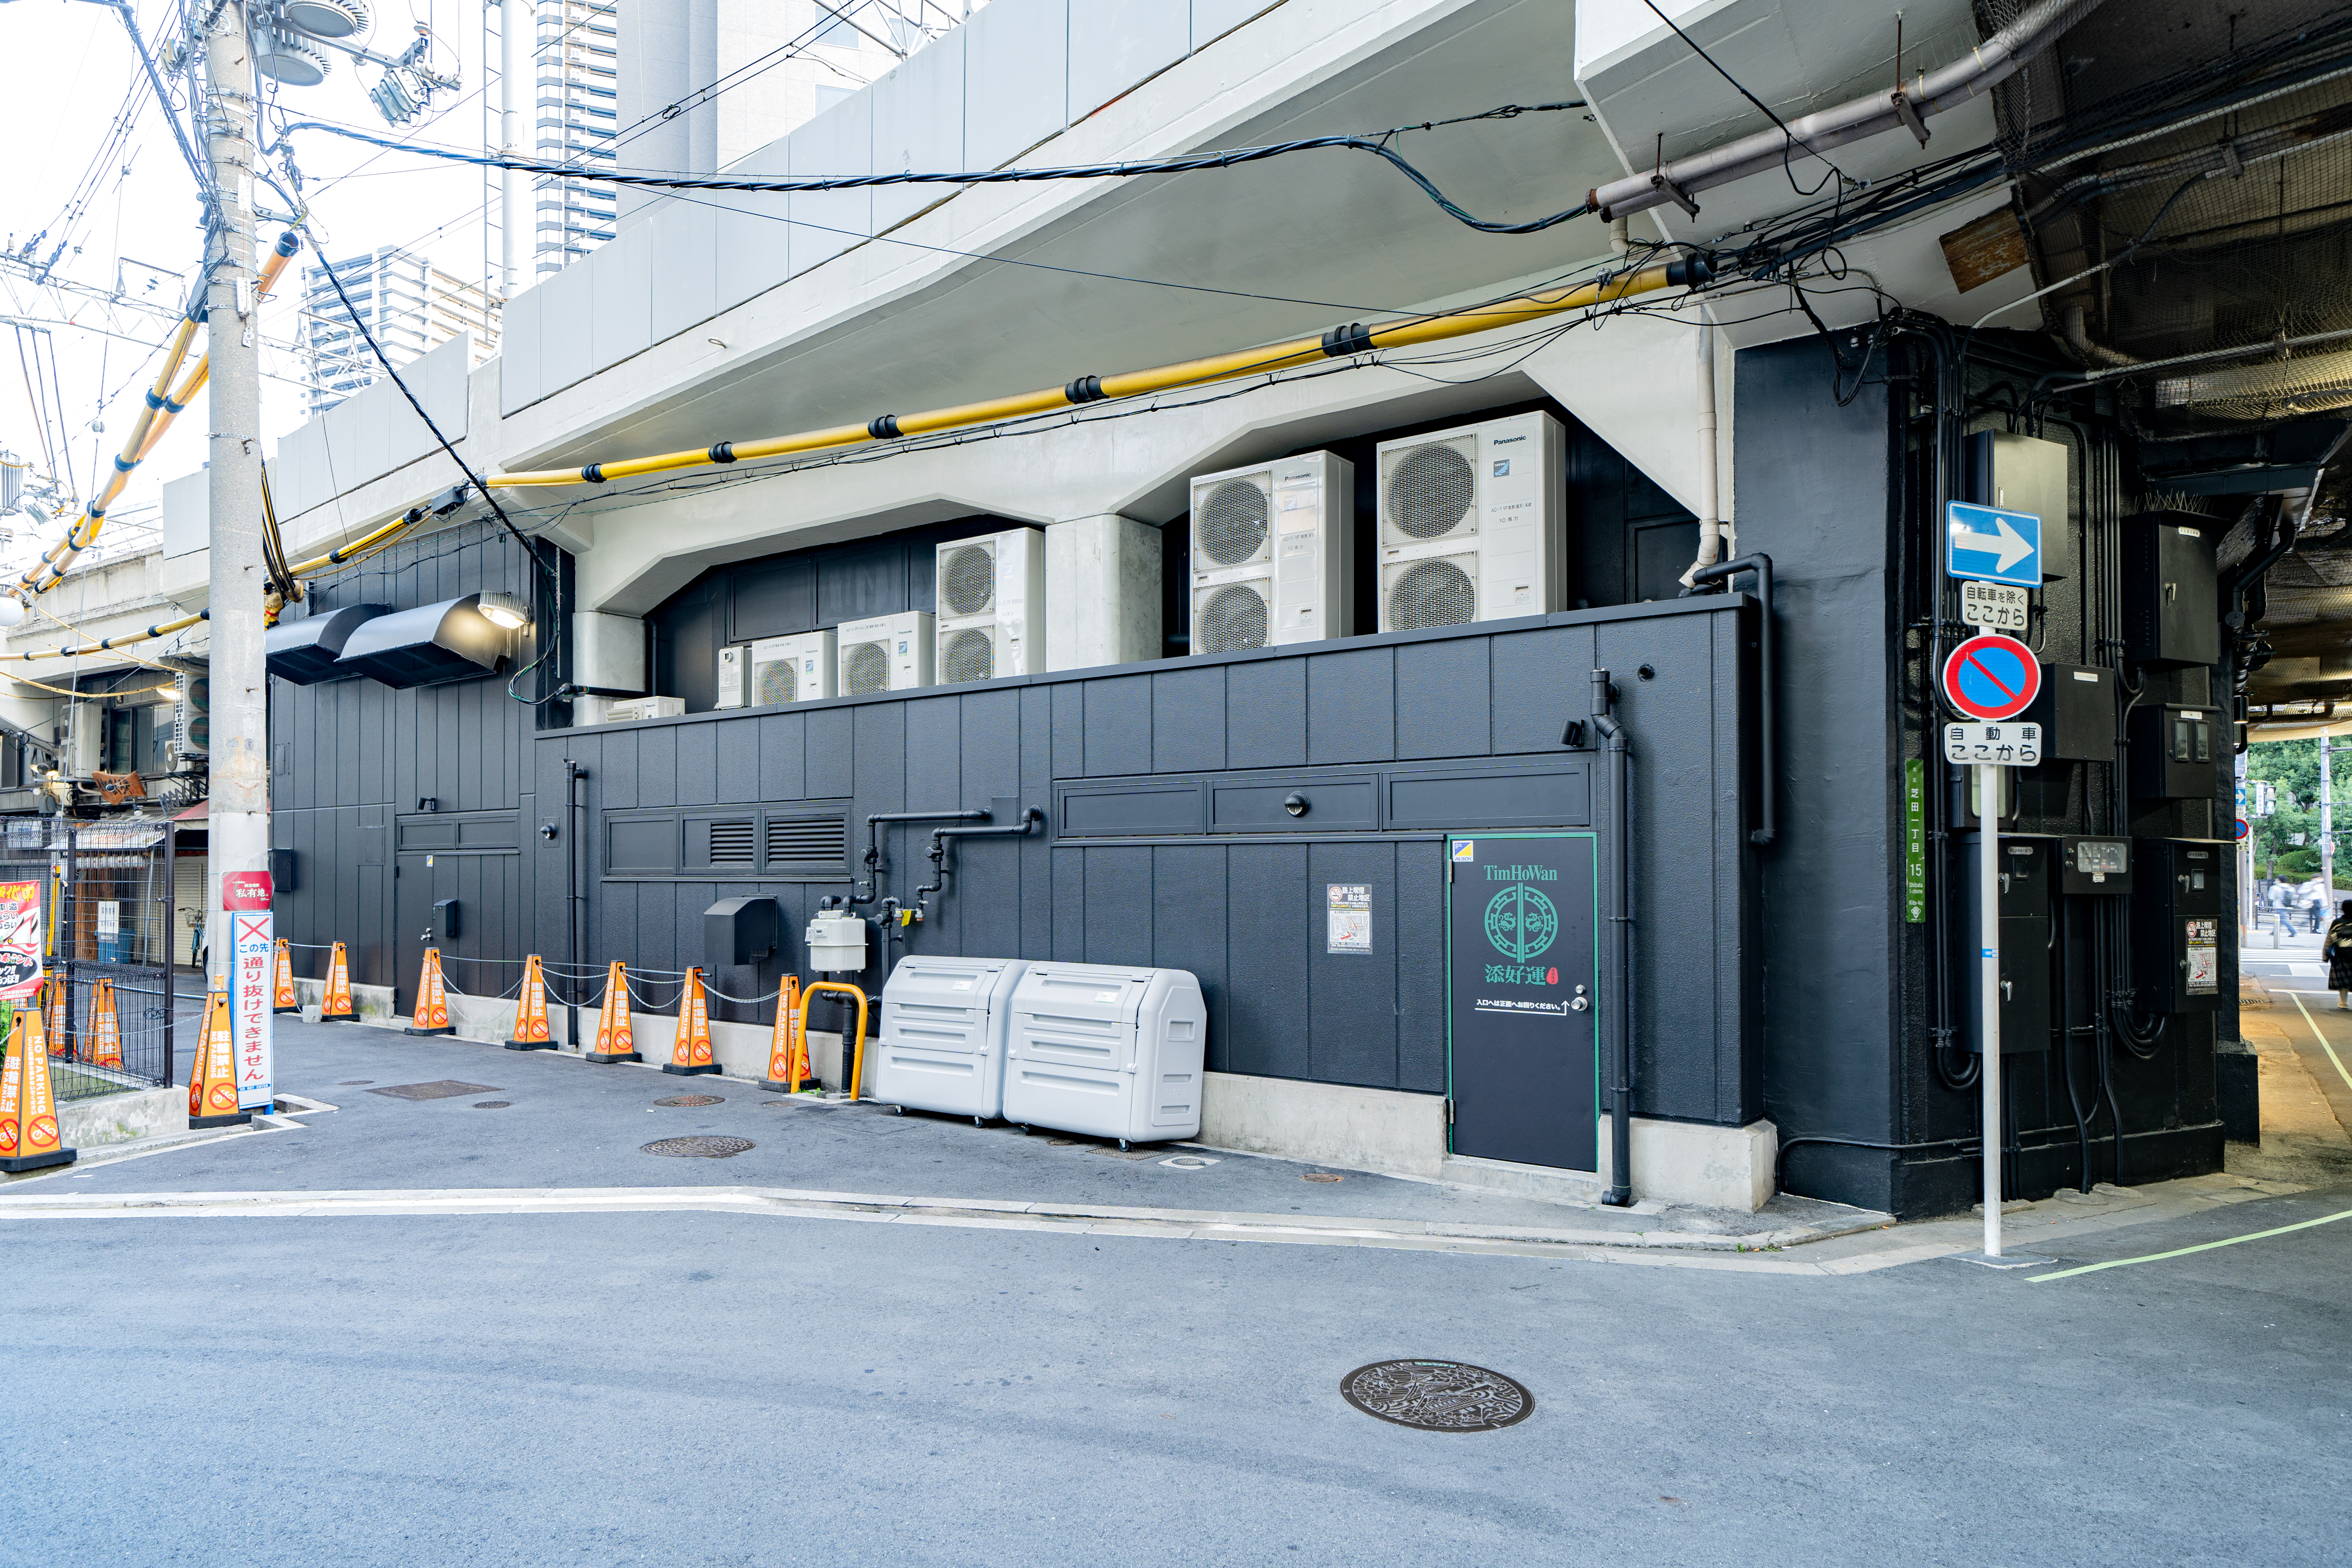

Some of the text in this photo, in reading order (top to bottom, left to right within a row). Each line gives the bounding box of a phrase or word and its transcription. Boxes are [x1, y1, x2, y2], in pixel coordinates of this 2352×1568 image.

[1494, 436, 1526, 445] Panasonic
[1285, 472, 1311, 481] Panasonic
[1967, 586, 2024, 605] 自転車を除く
[1967, 604, 2025, 626] ここから
[1951, 726, 2036, 740] 自動車
[1951, 745, 2036, 761] ここから
[1911, 788, 1919, 853] 芝田一丁目
[1484, 865, 1558, 881] TimHoWan
[1910, 864, 1922, 876] 15
[236, 888, 265, 898] 私有地
[240, 943, 269, 953] この先
[426, 963, 429, 973] NO
[1485, 964, 1546, 985] 添好運
[526, 971, 530, 982] NO
[610, 978, 614, 989] NO
[687, 985, 691, 997] NO
[520, 985, 528, 1018] PARKING
[693, 999, 697, 1007] NO
[782, 995, 787, 1007] NO
[1477, 999, 1560, 1010] 入口へは正面へお回りください。
[603, 992, 612, 1028] PARKING
[697, 998, 706, 1036] 駐輪禁止
[790, 1009, 793, 1018] NO
[205, 1014, 210, 1029] NO
[243, 957, 264, 1081] 通り抜けできません
[211, 1031, 217, 1042] NO
[197, 1033, 208, 1081] PARKING
[216, 1030, 230, 1078] 駐輪禁止
[34, 1036, 46, 1114] NO PARKING
[0, 1057, 11, 1112] NO PARKING
[5, 1056, 20, 1112] 駐輪禁止
[1165, 1089, 1188, 1100] SEKISUI
